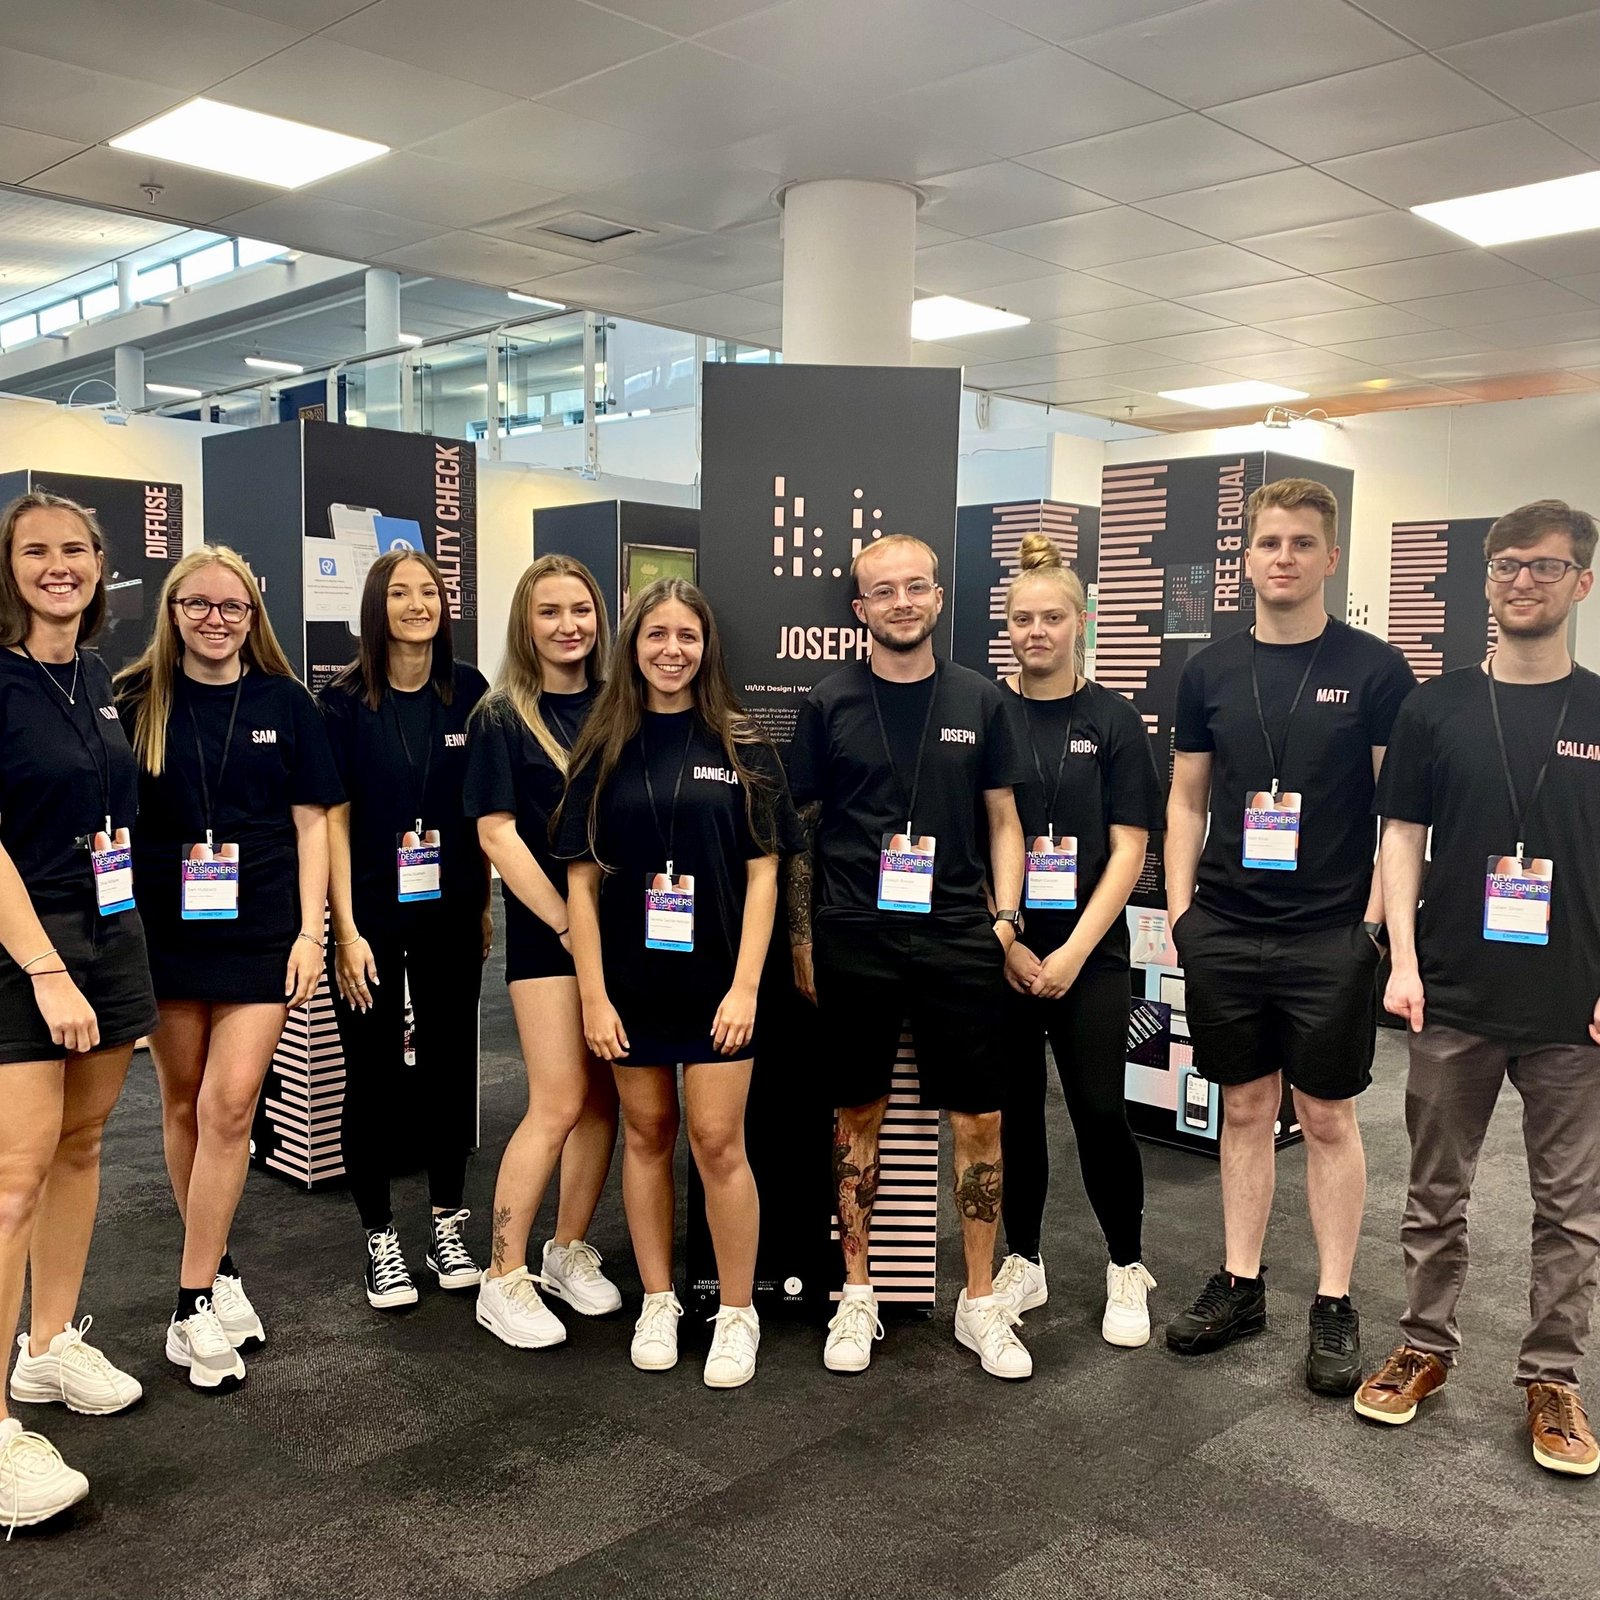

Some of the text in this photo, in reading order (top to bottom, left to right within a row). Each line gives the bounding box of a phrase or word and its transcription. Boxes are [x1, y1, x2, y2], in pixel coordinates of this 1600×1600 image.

[436, 443, 460, 521] CHECK
[145, 485, 168, 559] DIFFUSE
[1214, 458, 1245, 612] FREE & EQUAL
[776, 626, 873, 660] JOSEPH
[767, 685, 792, 693] Design
[1316, 688, 1350, 704] MATT
[252, 729, 277, 744] SAM
[939, 728, 976, 745] JOSEPH
[1246, 807, 1266, 815] NEW
[1248, 815, 1297, 824] DESIGNERS
[400, 851, 439, 861] DESIGNERS
[884, 848, 903, 857] NEW
[96, 853, 130, 867] DESIGNERS
[185, 859, 206, 867] NEW
[885, 856, 933, 867] DESIGNERS
[1030, 858, 1076, 866] DESIGNERS
[187, 866, 237, 874] DESIGNERS
[1490, 873, 1512, 882] NEW
[648, 888, 665, 896] NEW
[1492, 881, 1549, 894] DESIGNERS
[650, 896, 693, 907] DESIGNERS
